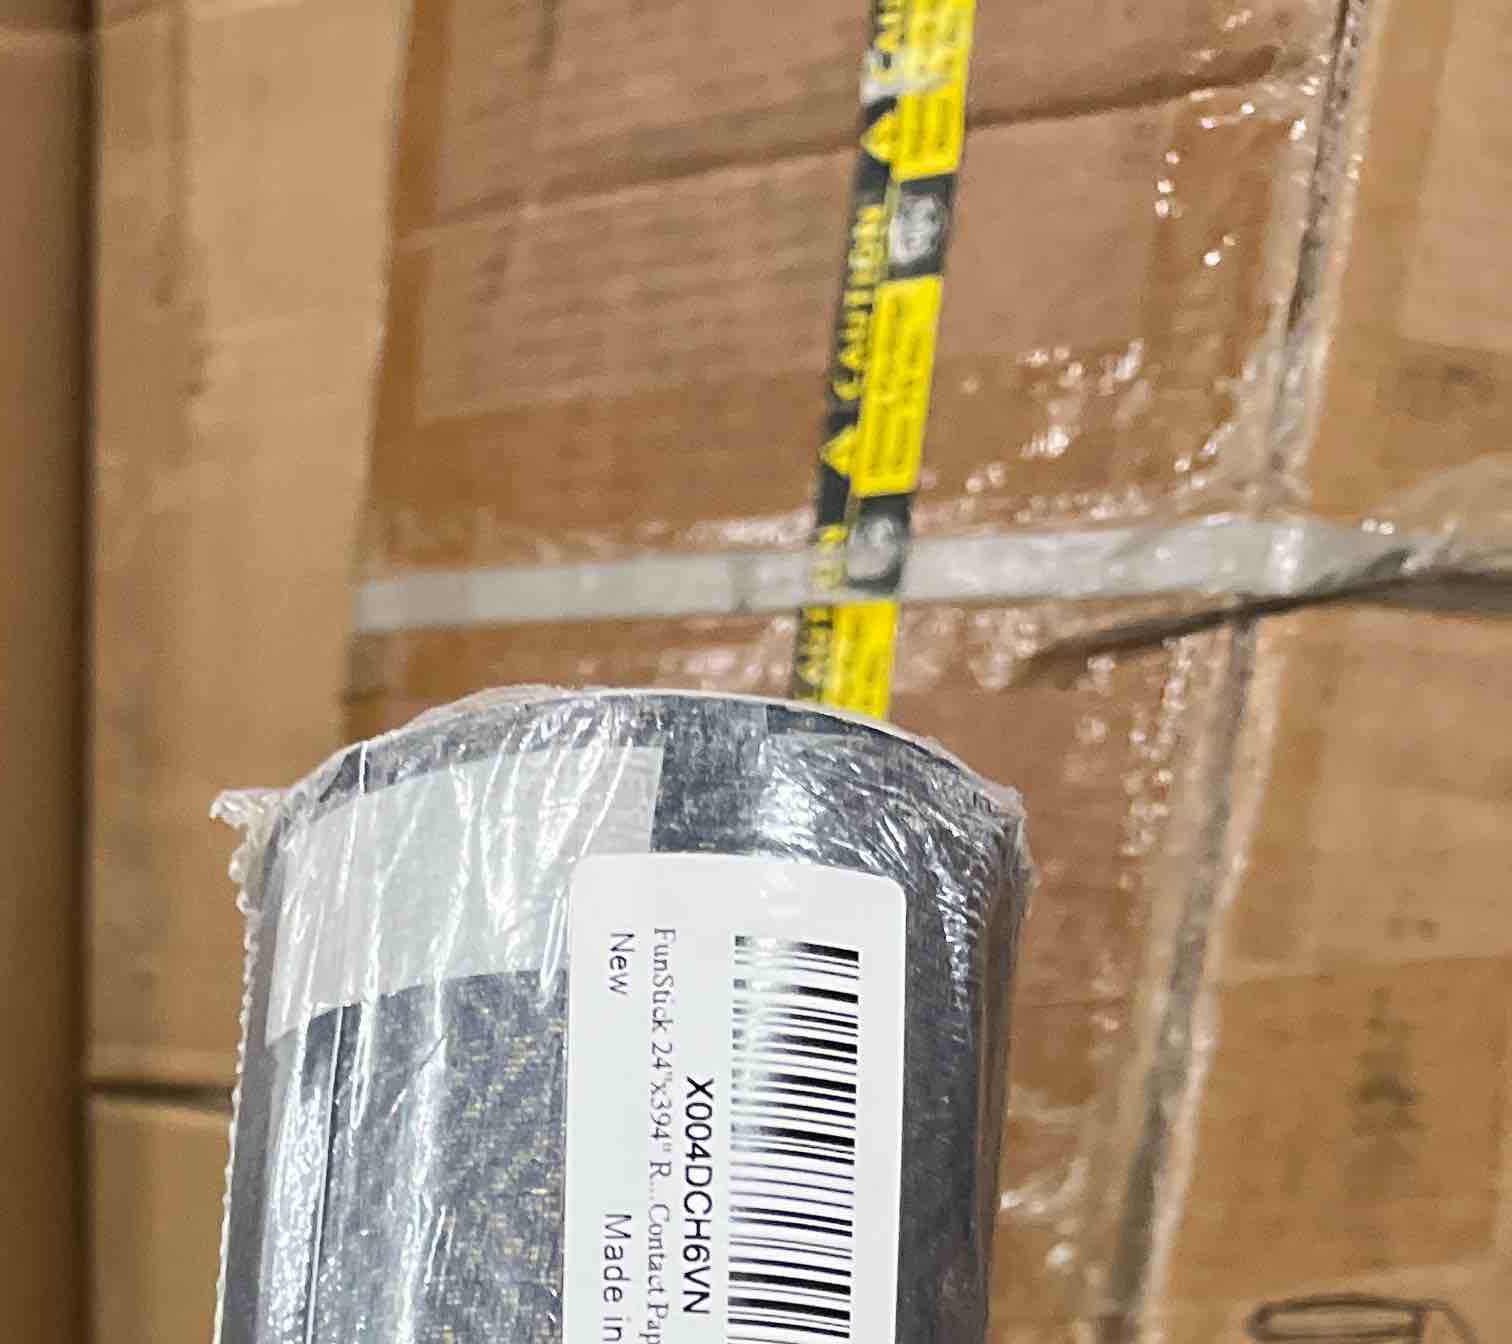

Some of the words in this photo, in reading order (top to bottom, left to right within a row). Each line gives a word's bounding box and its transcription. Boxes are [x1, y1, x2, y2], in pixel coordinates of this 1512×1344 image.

[608, 932, 636, 997] New
[652, 928, 677, 1033] FunStick
[682, 1075, 715, 1315] X004DCH6VN
[603, 1213, 633, 1304] Made
[602, 1316, 631, 1343] in
